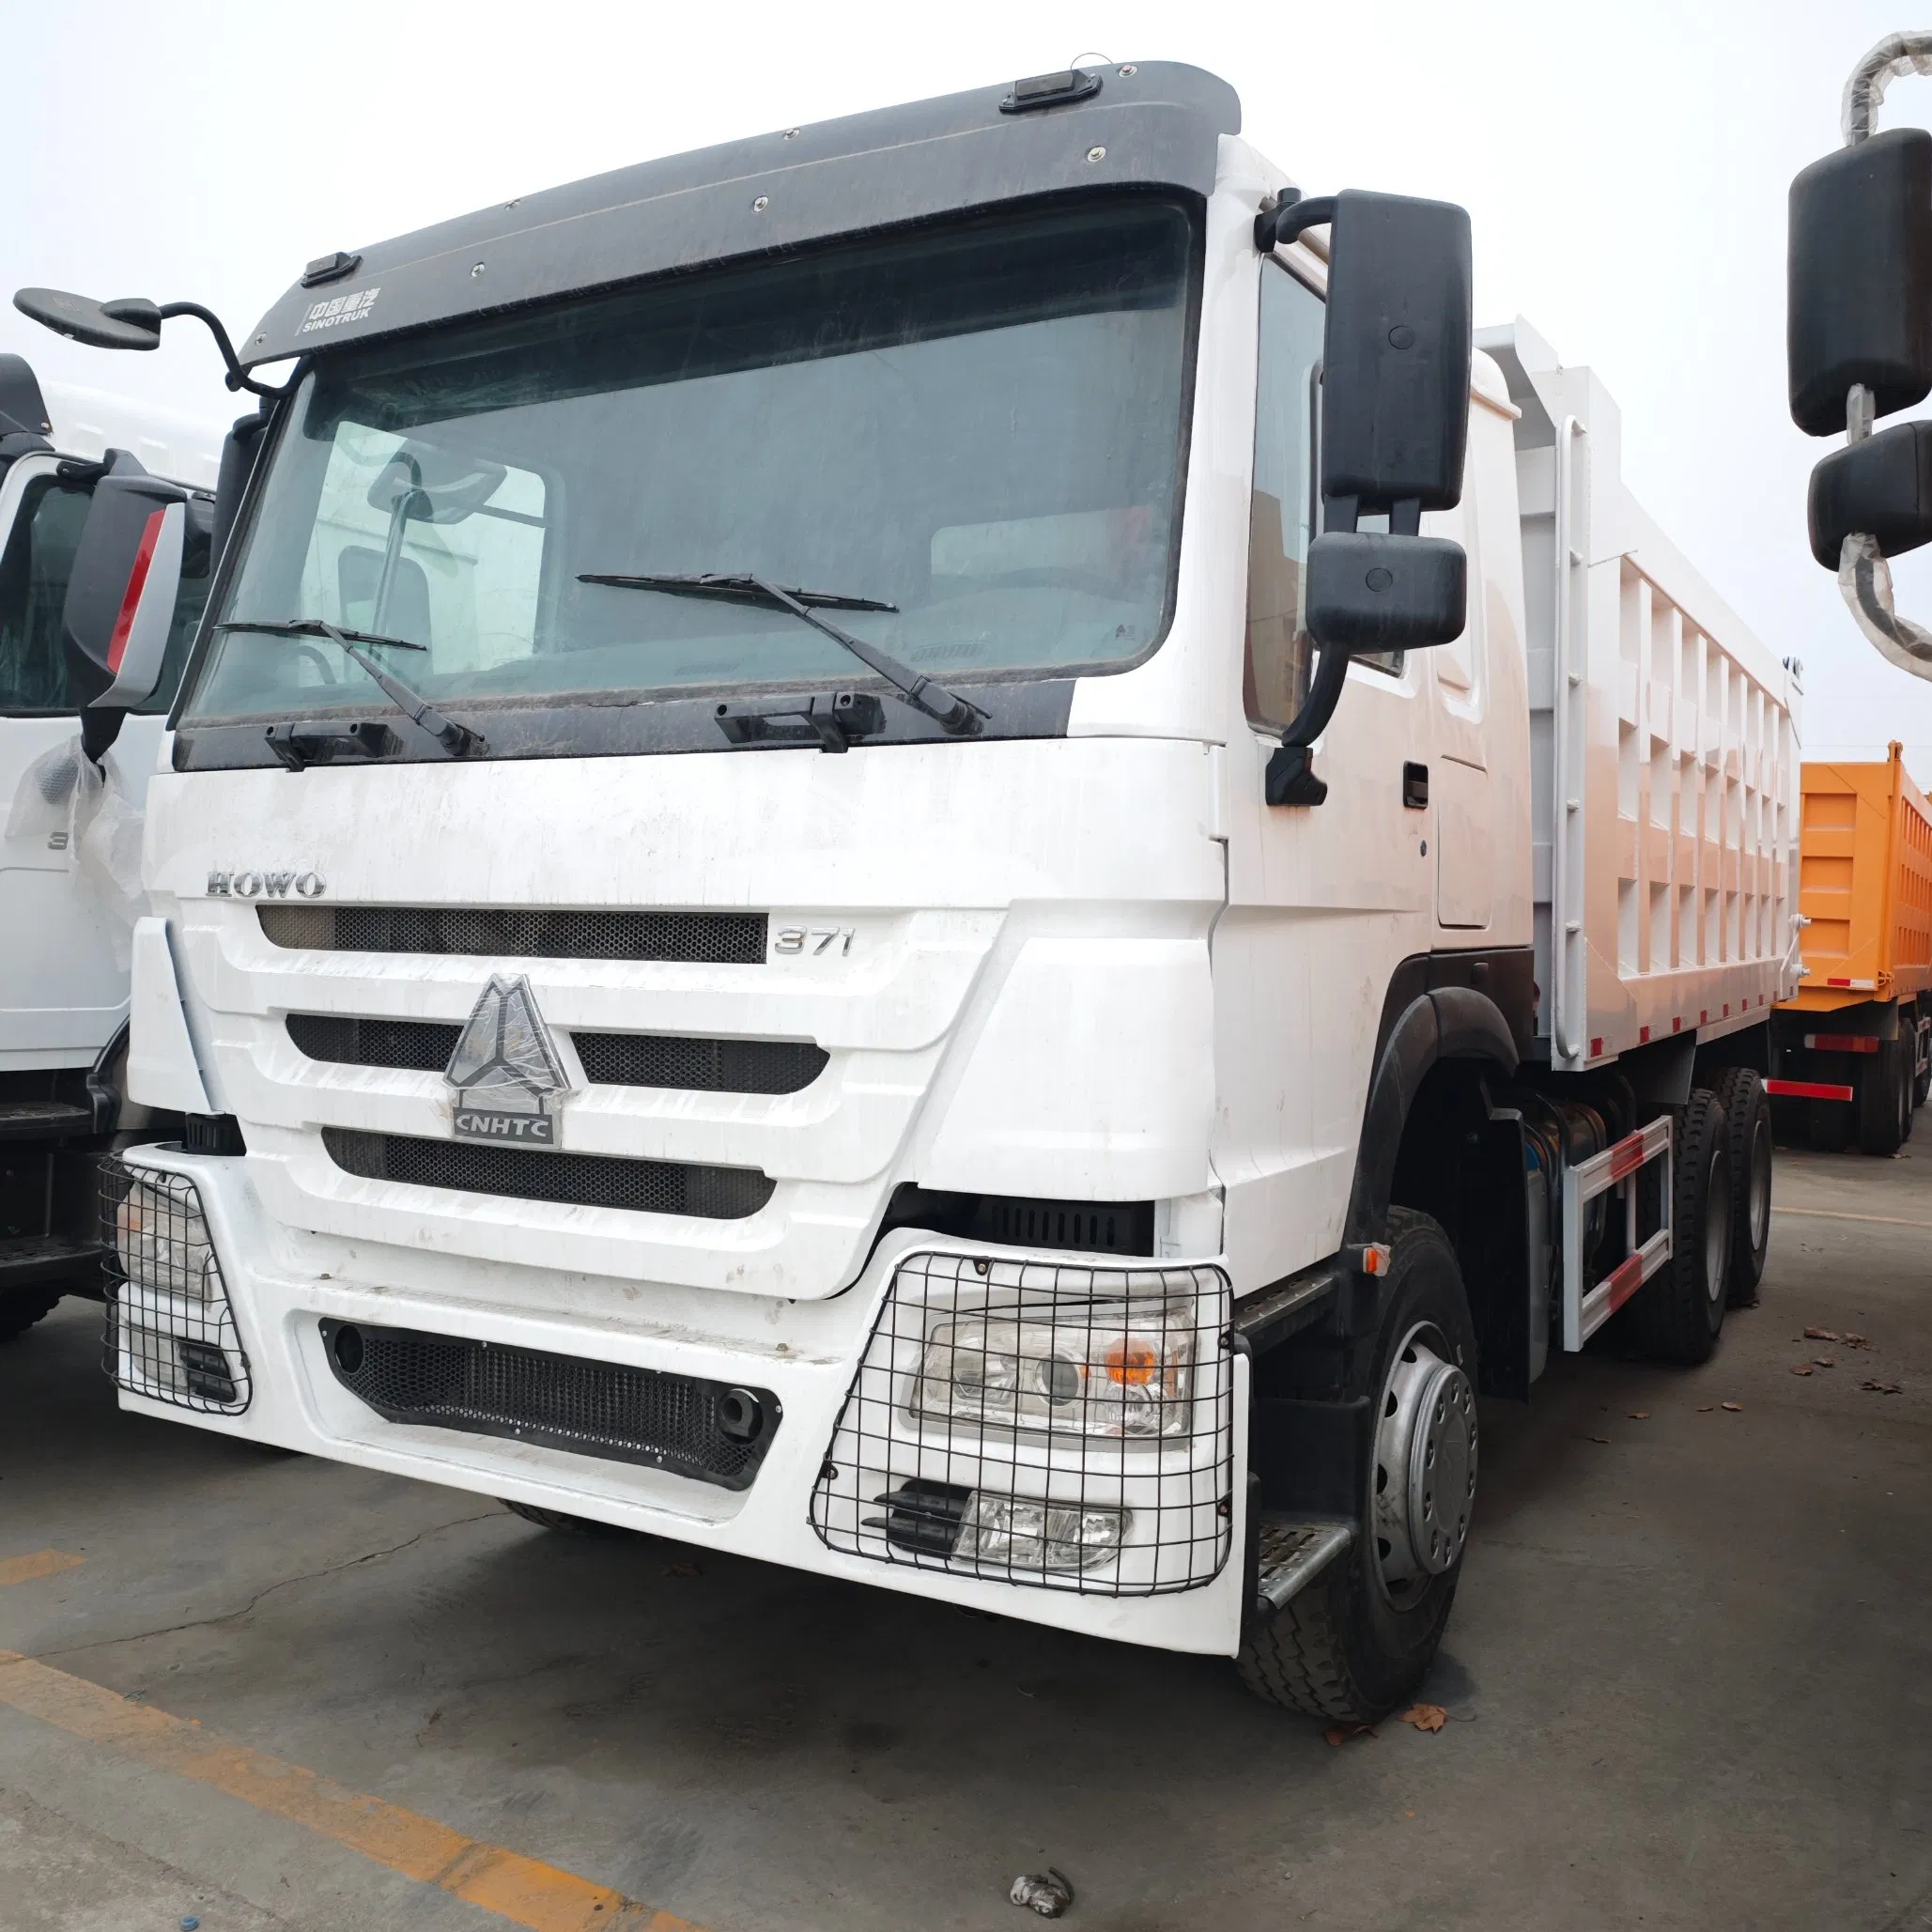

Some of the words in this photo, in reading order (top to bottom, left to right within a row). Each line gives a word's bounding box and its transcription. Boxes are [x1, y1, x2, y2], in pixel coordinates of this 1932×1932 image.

[302, 307, 372, 332] SINOTRUK
[206, 872, 327, 898] HOWO
[774, 925, 856, 956] 371
[456, 1114, 549, 1137] CNHTC
